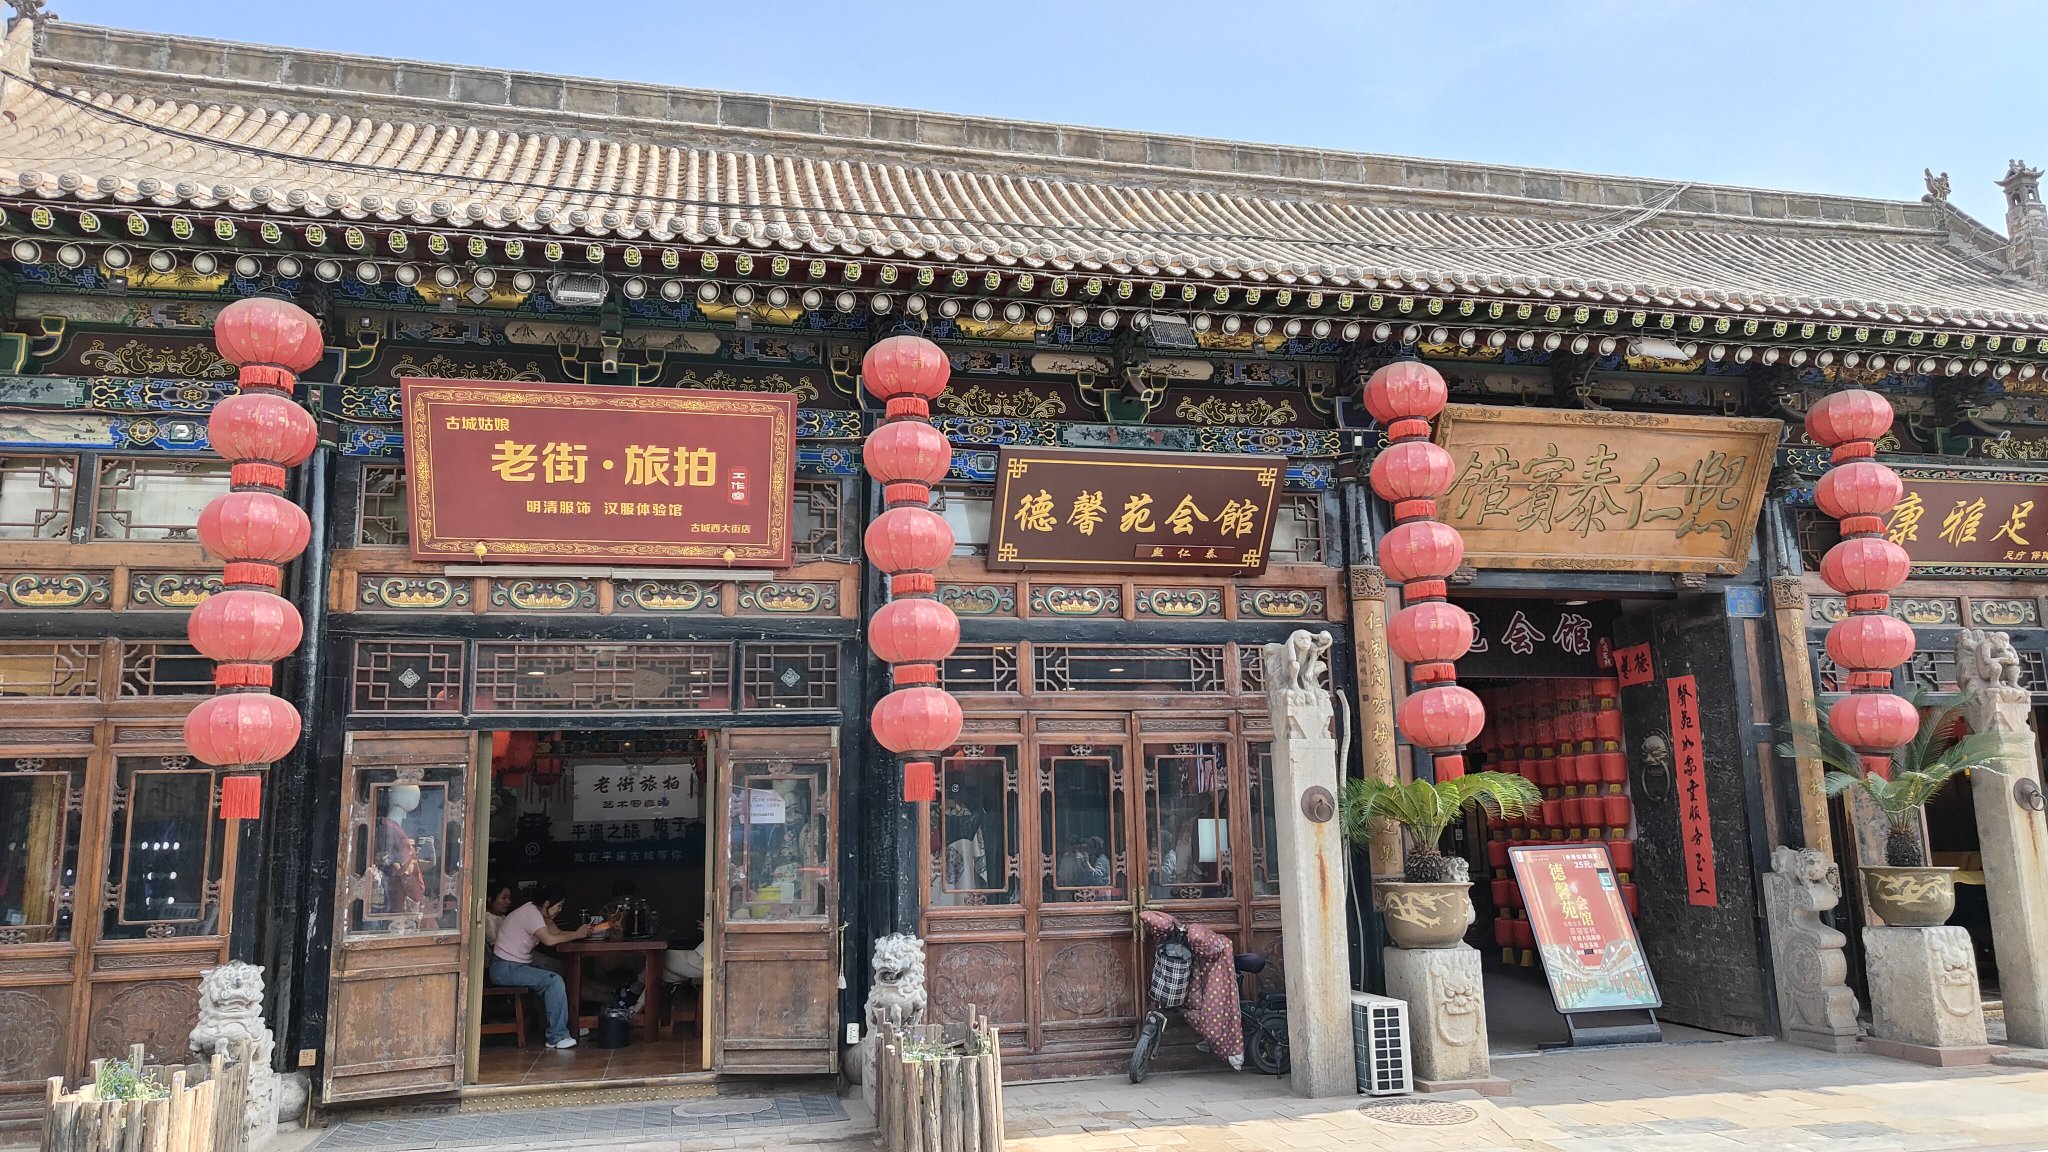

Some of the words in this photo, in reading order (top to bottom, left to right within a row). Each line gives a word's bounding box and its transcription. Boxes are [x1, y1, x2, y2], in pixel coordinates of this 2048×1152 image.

[445, 416, 510, 432] 古城姑娘
[491, 440, 717, 487] 老街·旅拍
[731, 472, 746, 501] 工作室
[526, 500, 591, 515] 明清服饰
[604, 501, 684, 518] 汉服体验馆
[690, 522, 752, 535] 古城西大街店
[2003, 550, 2027, 561] 足疗
[1575, 896, 1595, 927] 会馆
